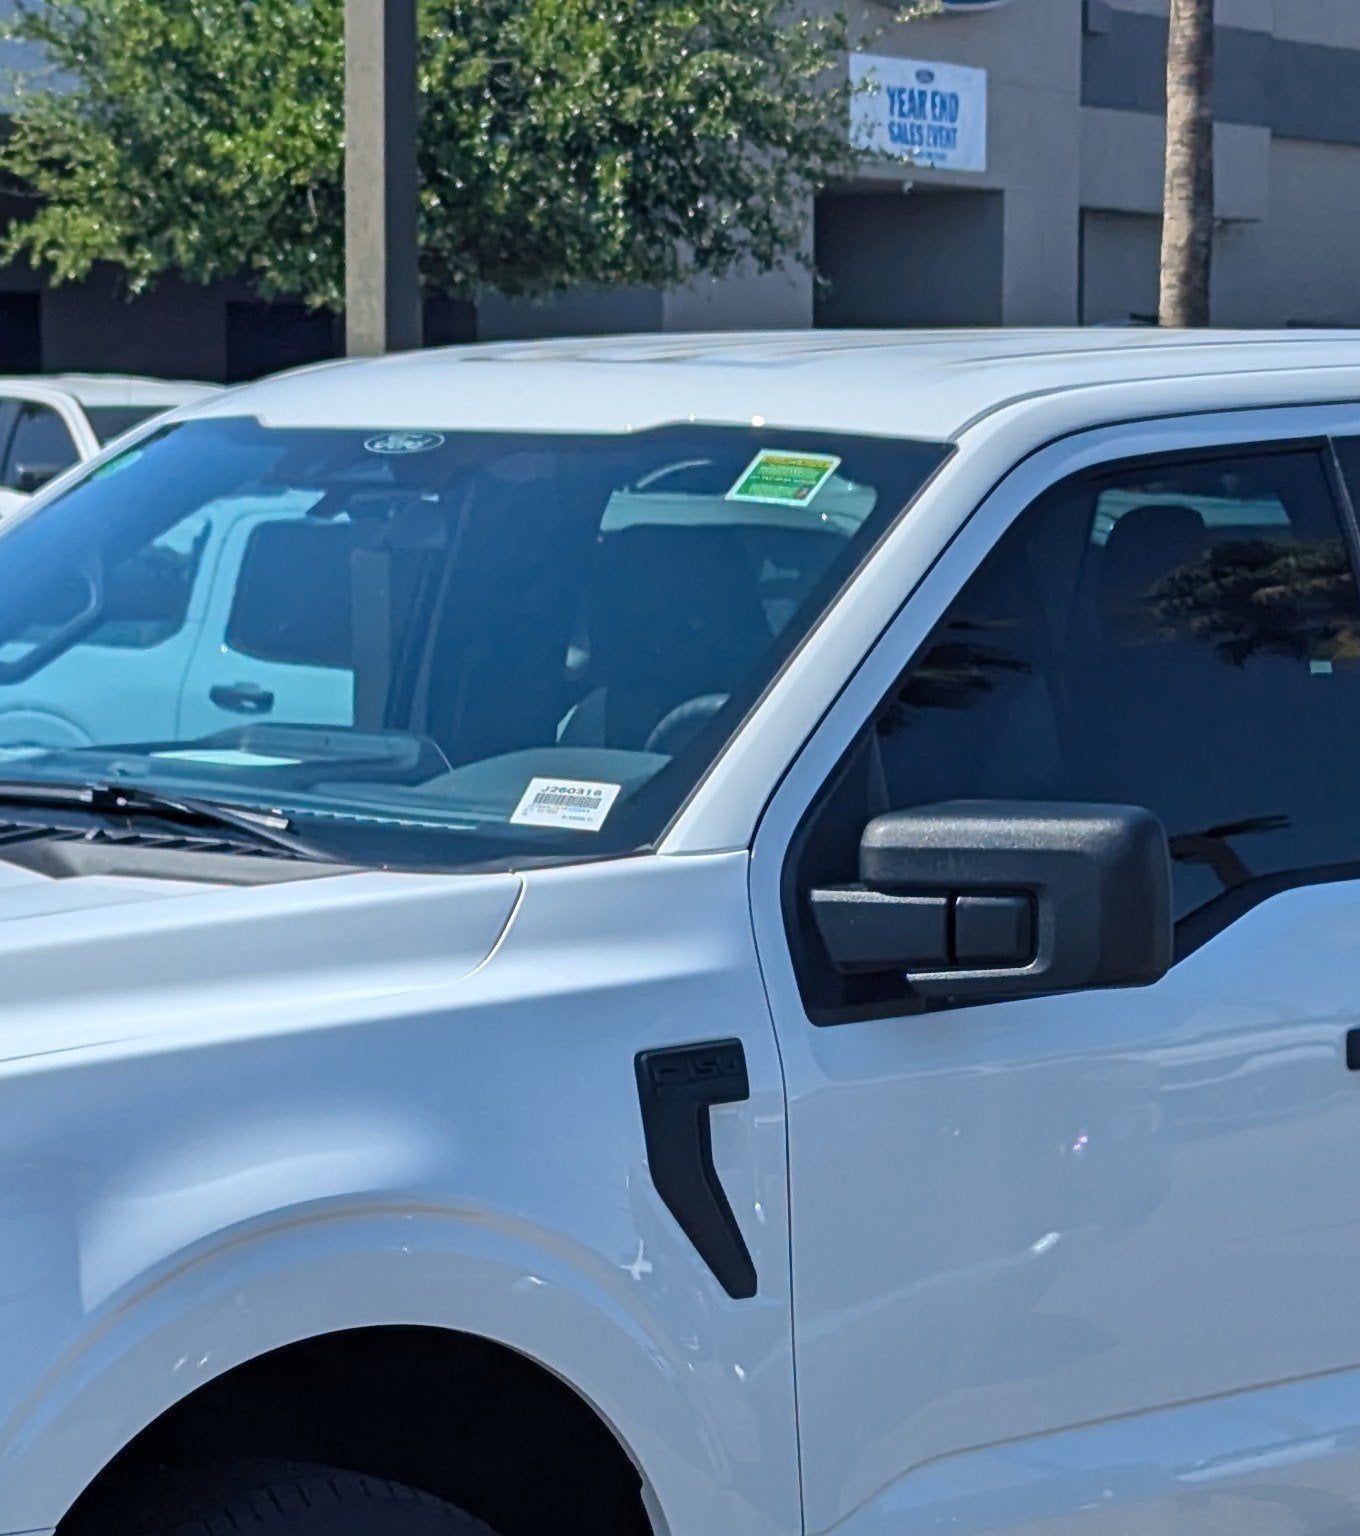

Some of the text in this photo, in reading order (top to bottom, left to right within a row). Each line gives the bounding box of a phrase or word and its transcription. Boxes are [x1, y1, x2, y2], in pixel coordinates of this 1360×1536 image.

[886, 86, 959, 124] YEAR END
[888, 121, 958, 149] SALES EVENT
